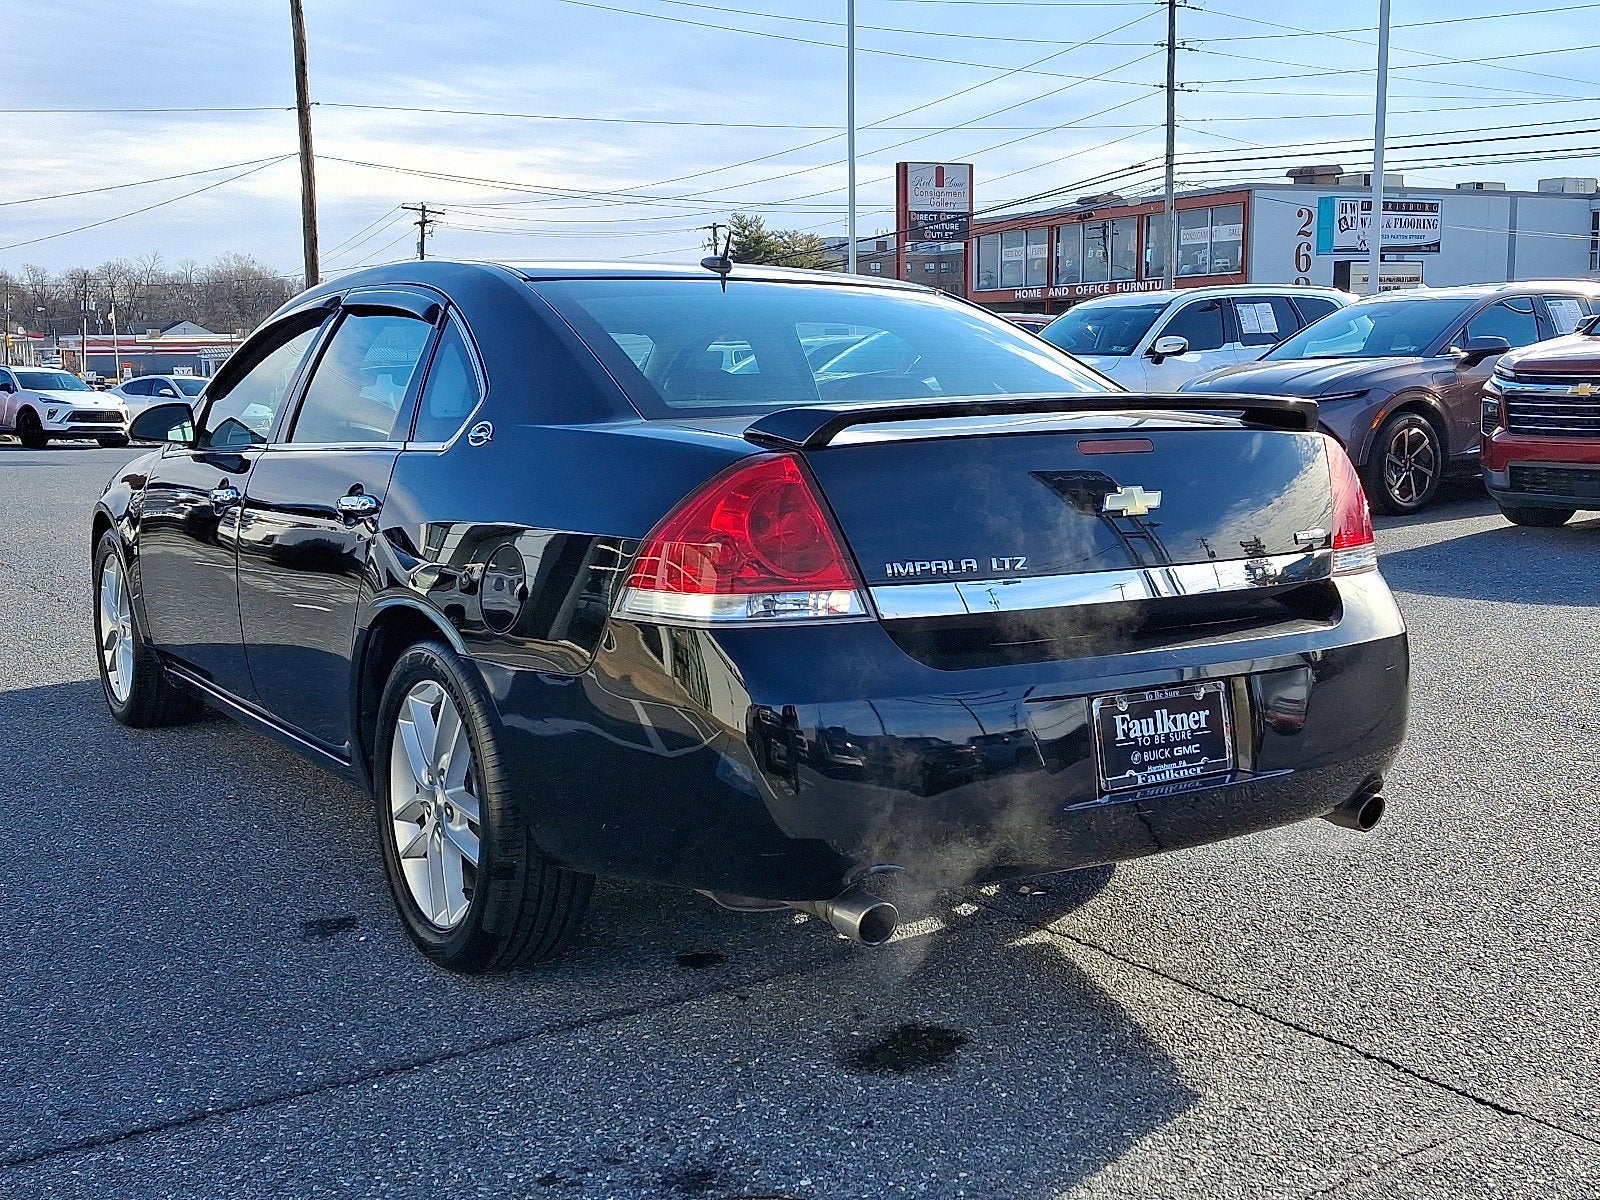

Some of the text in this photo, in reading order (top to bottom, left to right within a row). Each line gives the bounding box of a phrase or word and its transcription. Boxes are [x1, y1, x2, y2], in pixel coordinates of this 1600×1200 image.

[913, 187, 966, 199] Consignment
[929, 197, 957, 209] Gallery
[1362, 202, 1438, 212] HRRISBURG
[910, 211, 938, 221] DIRECT
[1386, 218, 1392, 229] &
[1394, 218, 1438, 230] FLOORING
[924, 230, 954, 239] OUTLET
[1015, 279, 1175, 299] HOME AND OFFICE FURNITUE
[885, 556, 1028, 578] IMPALA LTZ
[1144, 689, 1180, 700] To Be Sure
[1113, 708, 1210, 741] Faulkner
[1137, 729, 1192, 747] TO BE SURE
[1143, 743, 1201, 762] BUICK GMC
[1137, 766, 1204, 785] Faulkner
